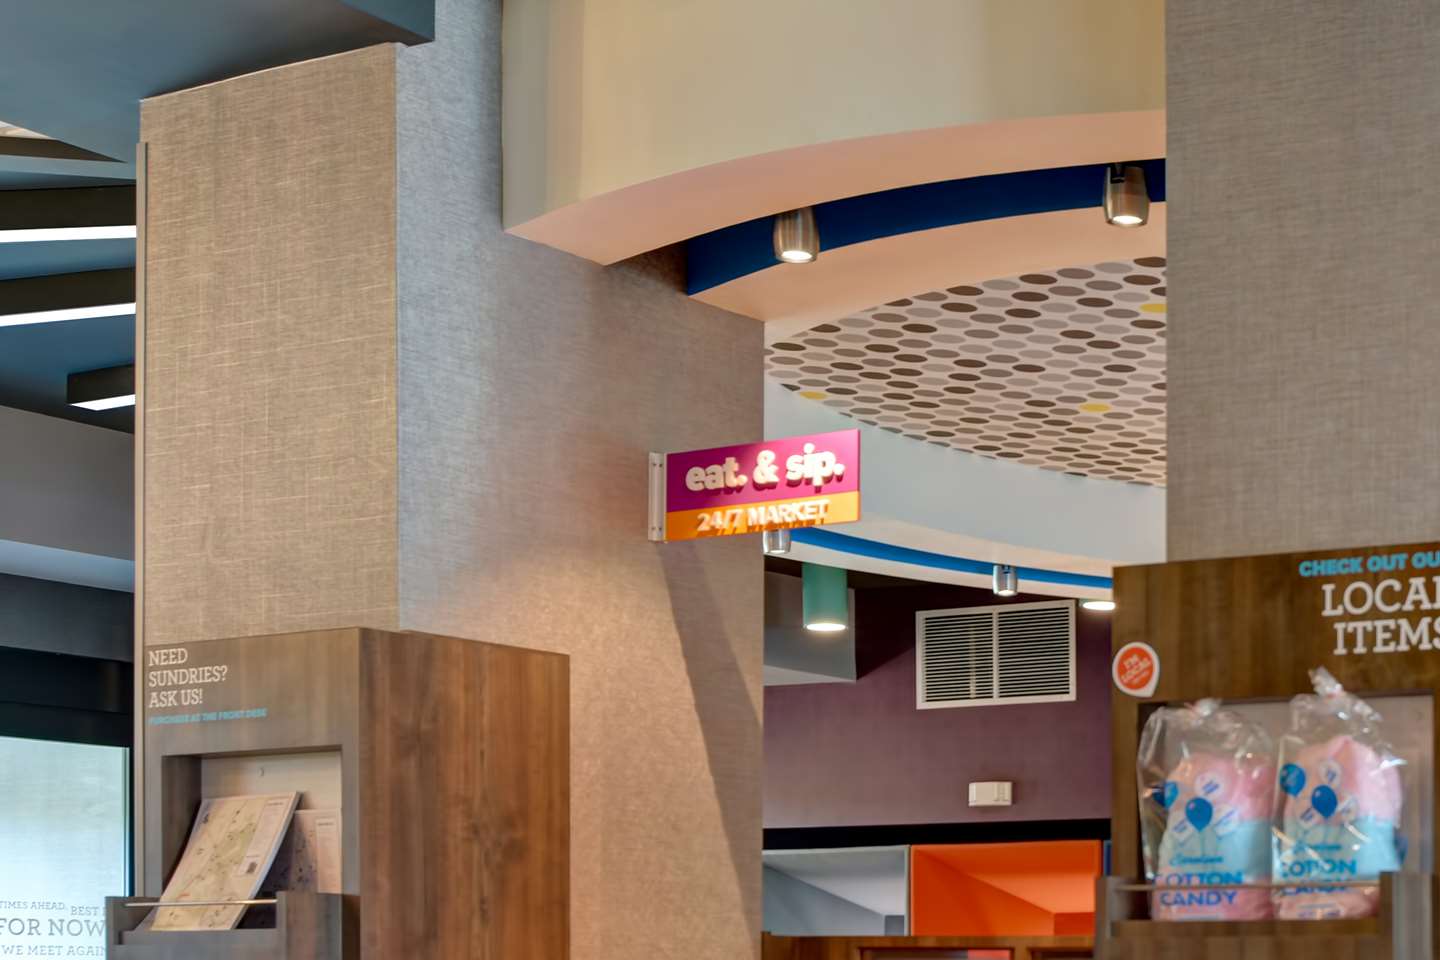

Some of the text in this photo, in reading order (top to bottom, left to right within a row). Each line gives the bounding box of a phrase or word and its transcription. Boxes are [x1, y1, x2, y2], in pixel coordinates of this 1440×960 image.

[685, 443, 845, 491] eat. & sip.
[697, 500, 831, 531] 24/7 MARKET
[1299, 556, 1363, 577] CHECK
[1367, 554, 1409, 573] OUT
[148, 648, 188, 666] NEED
[149, 665, 228, 687] SUNDRIES?
[149, 689, 203, 708] ASK US!
[1160, 890, 1236, 907] CANDY
[27, 945, 63, 956] MEET
